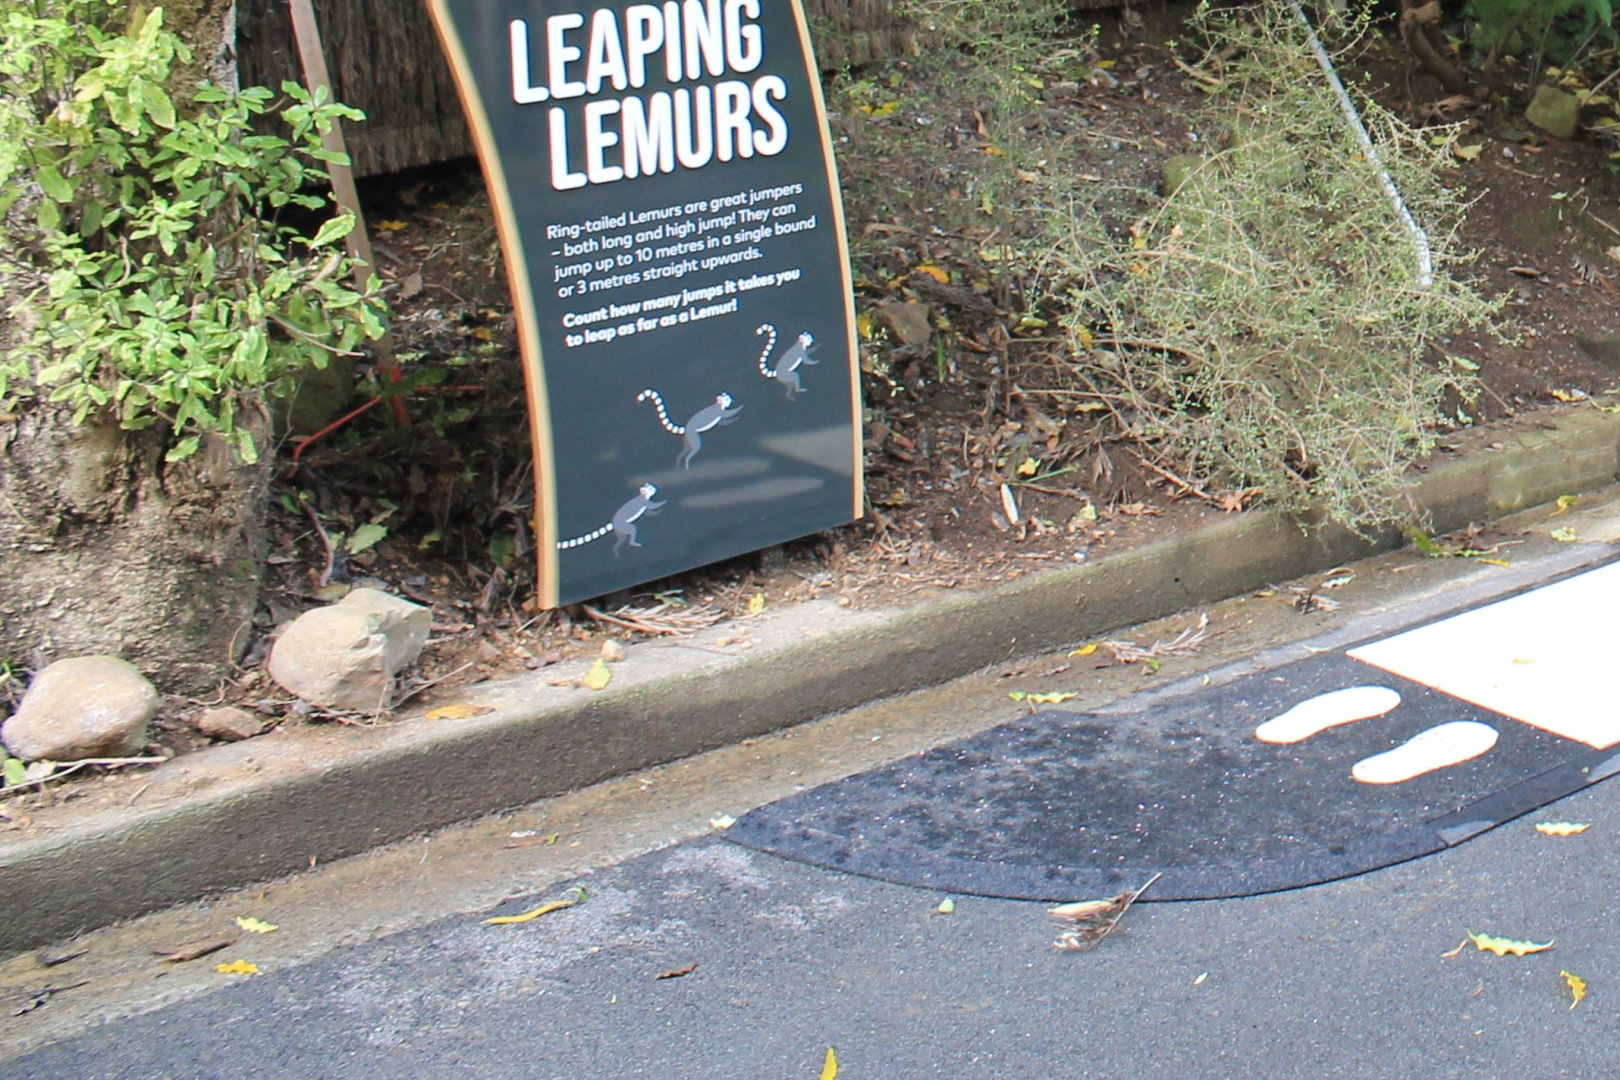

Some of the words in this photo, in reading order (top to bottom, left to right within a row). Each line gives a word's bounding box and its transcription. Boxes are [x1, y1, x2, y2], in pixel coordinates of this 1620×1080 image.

[549, 74, 788, 191] LEMURS
[547, 212, 626, 240] Ring-tailed
[629, 205, 683, 225] Lemurs
[684, 201, 708, 214] are
[709, 192, 748, 212] great
[749, 183, 803, 205] jumpers
[564, 238, 599, 257] both
[601, 235, 633, 249] long
[635, 225, 663, 243] and
[665, 220, 696, 238] high
[698, 212, 736, 234] jump!
[738, 208, 771, 223] They
[772, 203, 796, 217] can
[554, 262, 593, 283] jump
[595, 258, 614, 272] up
[616, 254, 633, 266] to
[635, 247, 653, 262] 10
[655, 240, 705, 259] metres
[707, 235, 720, 249] in
[722, 235, 732, 246] a
[734, 225, 773, 243] single
[774, 215, 816, 235] bound
[558, 285, 575, 298] or
[577, 280, 587, 294] 3
[589, 272, 641, 292] metres
[642, 259, 699, 281] straight
[701, 247, 763, 271] upwards.
[562, 307, 609, 328] Count
[609, 302, 642, 318] how
[642, 293, 682, 311] many
[682, 286, 724, 306] jumps
[724, 280, 737, 294] it
[737, 273, 775, 294] takes
[775, 269, 800, 286] you
[565, 334, 584, 347] to
[584, 326, 617, 343] leap
[617, 323, 636, 336] as
[636, 318, 659, 332] far
[659, 315, 678, 327] as
[678, 312, 689, 323] a
[690, 298, 738, 321] Lemur!
